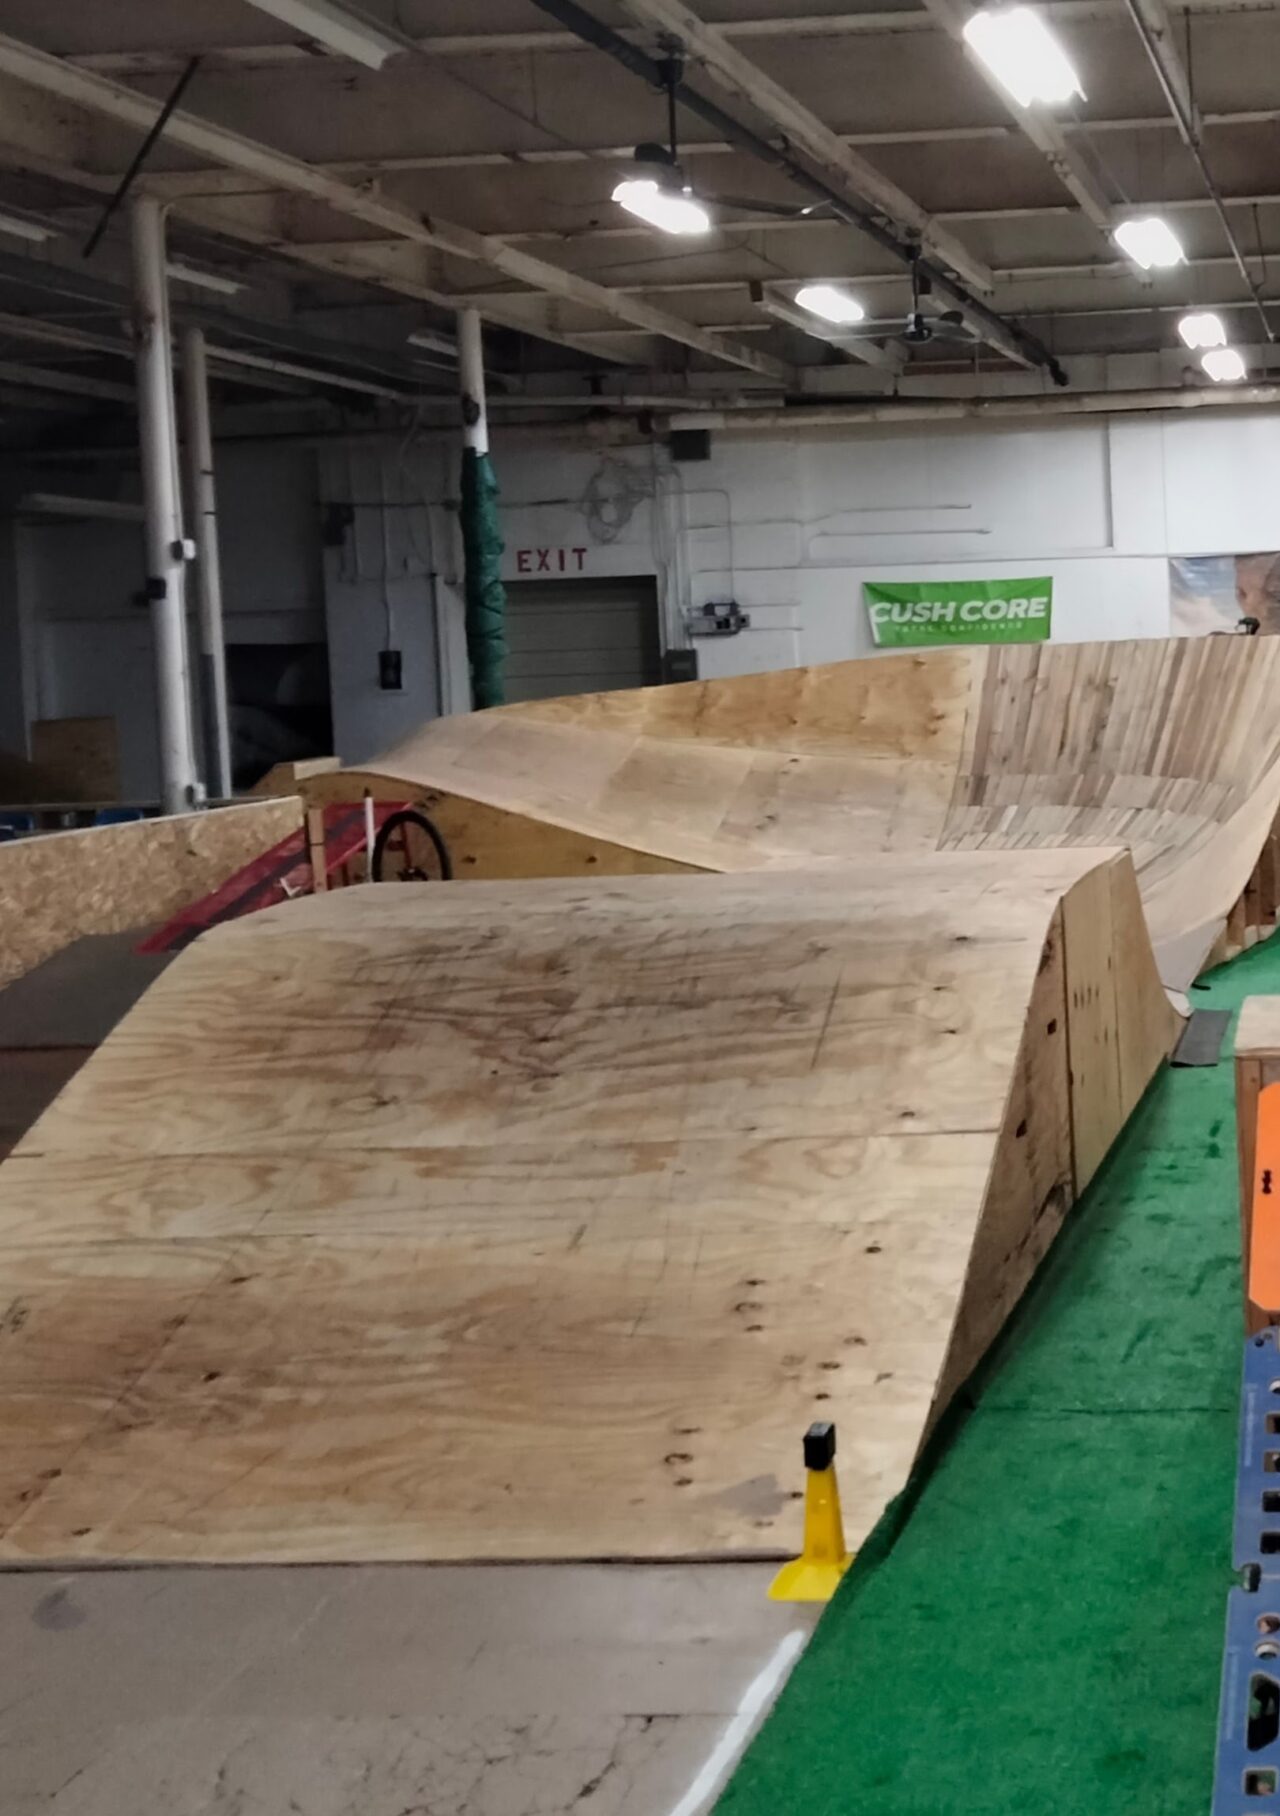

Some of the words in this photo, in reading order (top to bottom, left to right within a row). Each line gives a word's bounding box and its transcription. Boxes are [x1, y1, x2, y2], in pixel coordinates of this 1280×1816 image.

[517, 547, 587, 573] EXIT
[869, 602, 957, 624] CUSH
[959, 597, 1049, 622] CORE
